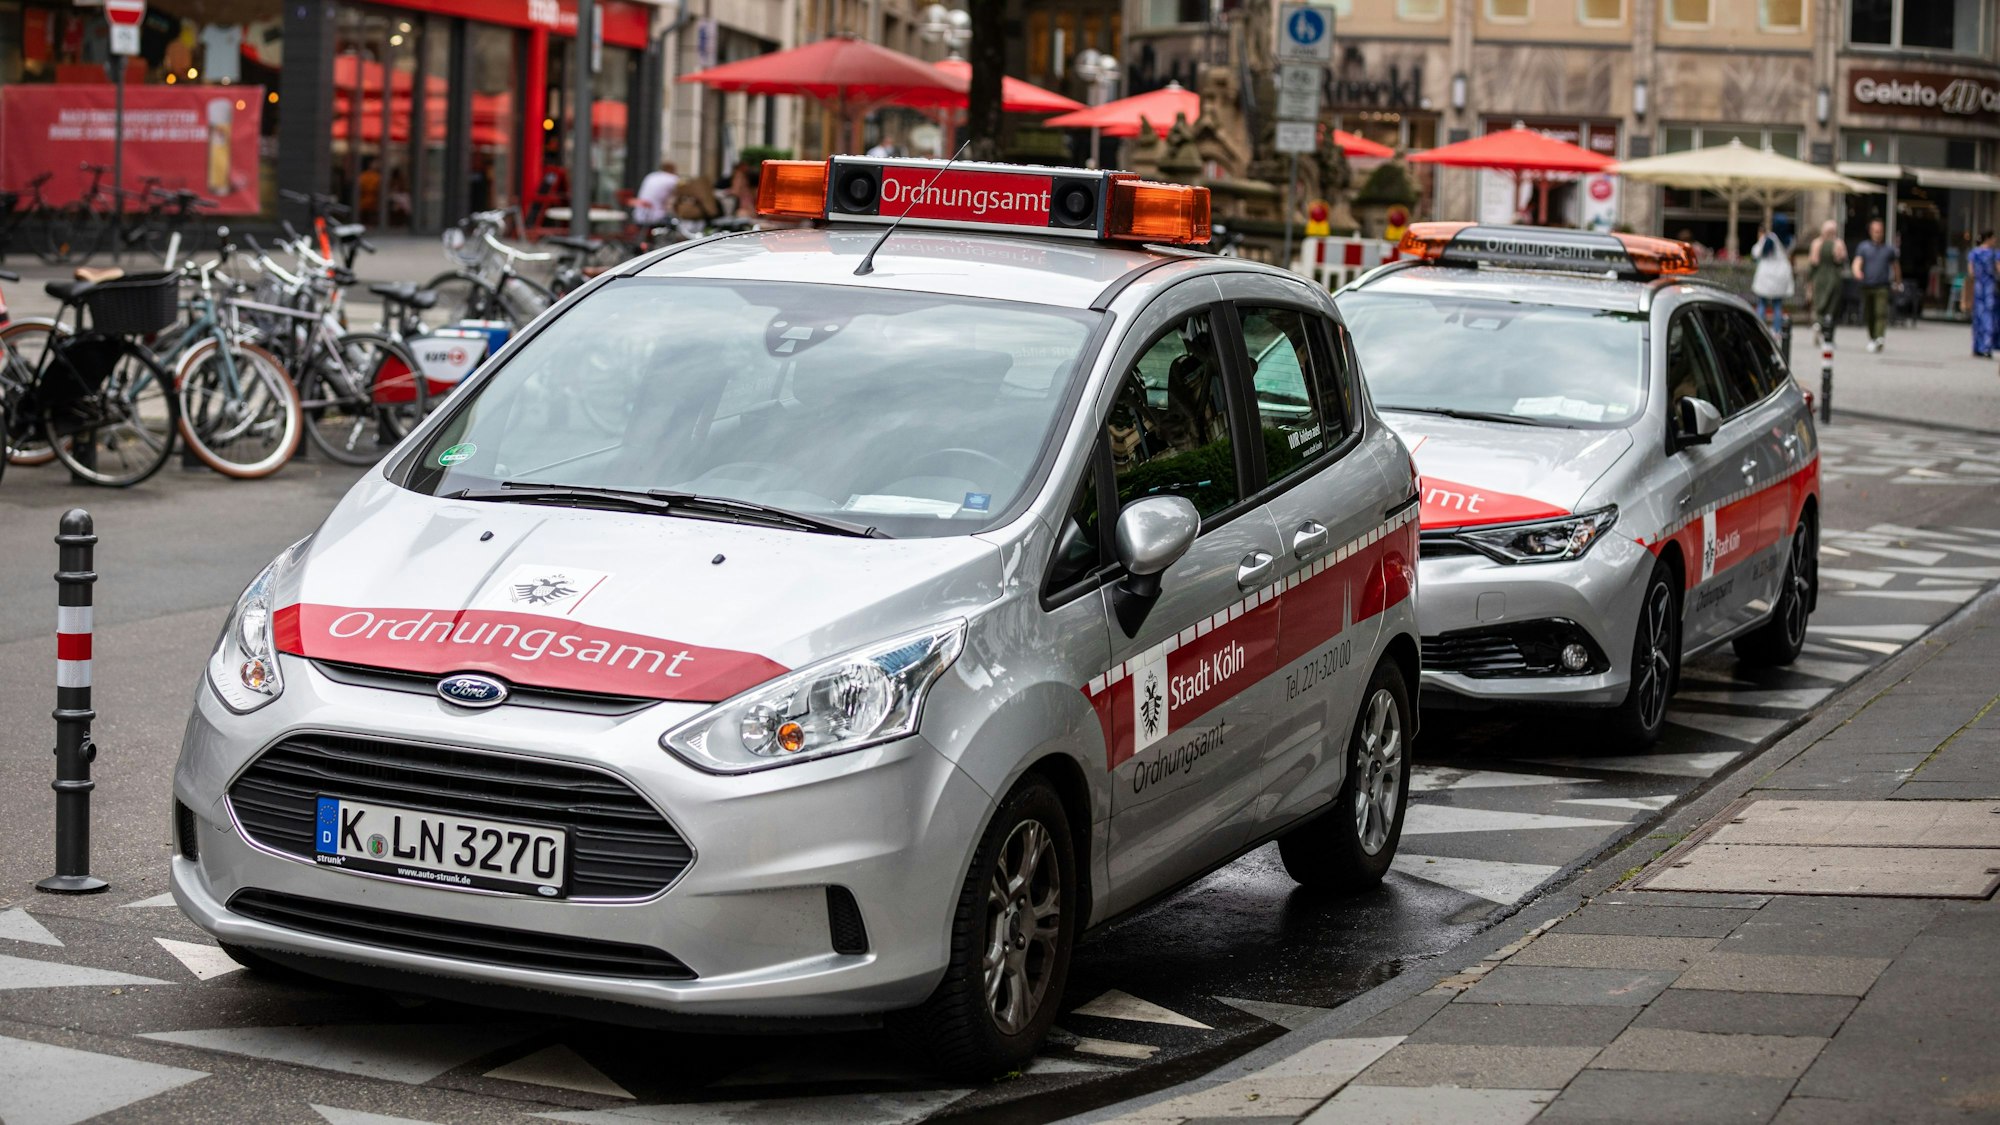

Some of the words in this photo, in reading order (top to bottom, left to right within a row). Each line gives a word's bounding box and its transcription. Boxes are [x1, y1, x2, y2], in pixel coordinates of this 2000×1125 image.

[1854, 77, 1937, 107] Gelato
[881, 178, 1051, 215] Ordnungsamt
[1486, 237, 1595, 260] Ordnungsamt
[328, 611, 695, 679] Ordnungsamt
[450, 680, 489, 698] Ford
[1170, 659, 1211, 711] Stadt
[1213, 640, 1245, 686] Köln
[1285, 668, 1300, 702] Tel.
[1133, 717, 1226, 794] Ordnungsamt
[322, 830, 332, 844] D
[341, 808, 366, 851] K
[393, 815, 445, 863] LN
[454, 824, 557, 879] 3270
[398, 867, 471, 885] www.auto-strunk.de
